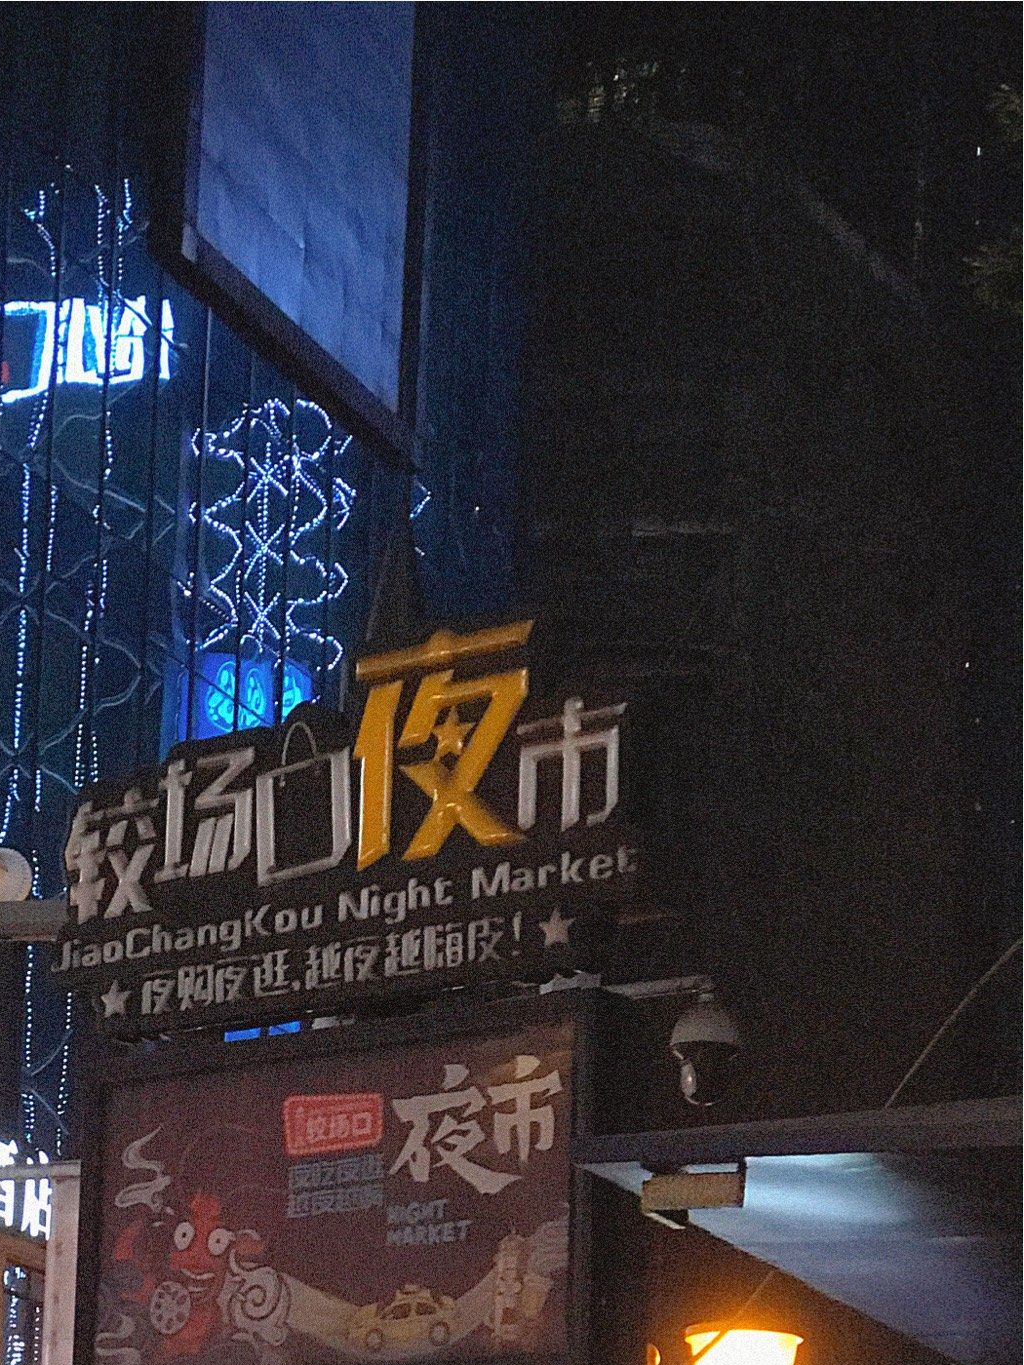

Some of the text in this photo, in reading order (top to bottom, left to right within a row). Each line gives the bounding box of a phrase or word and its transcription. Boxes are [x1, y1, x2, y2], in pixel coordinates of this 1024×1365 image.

[67, 618, 627, 926] 较场口夜市
[51, 845, 639, 973] JiaoChangKou Night Market
[389, 1055, 564, 1195] 夜市
[385, 1220, 473, 1246] MARKET
[386, 1199, 450, 1224] NIGHT
